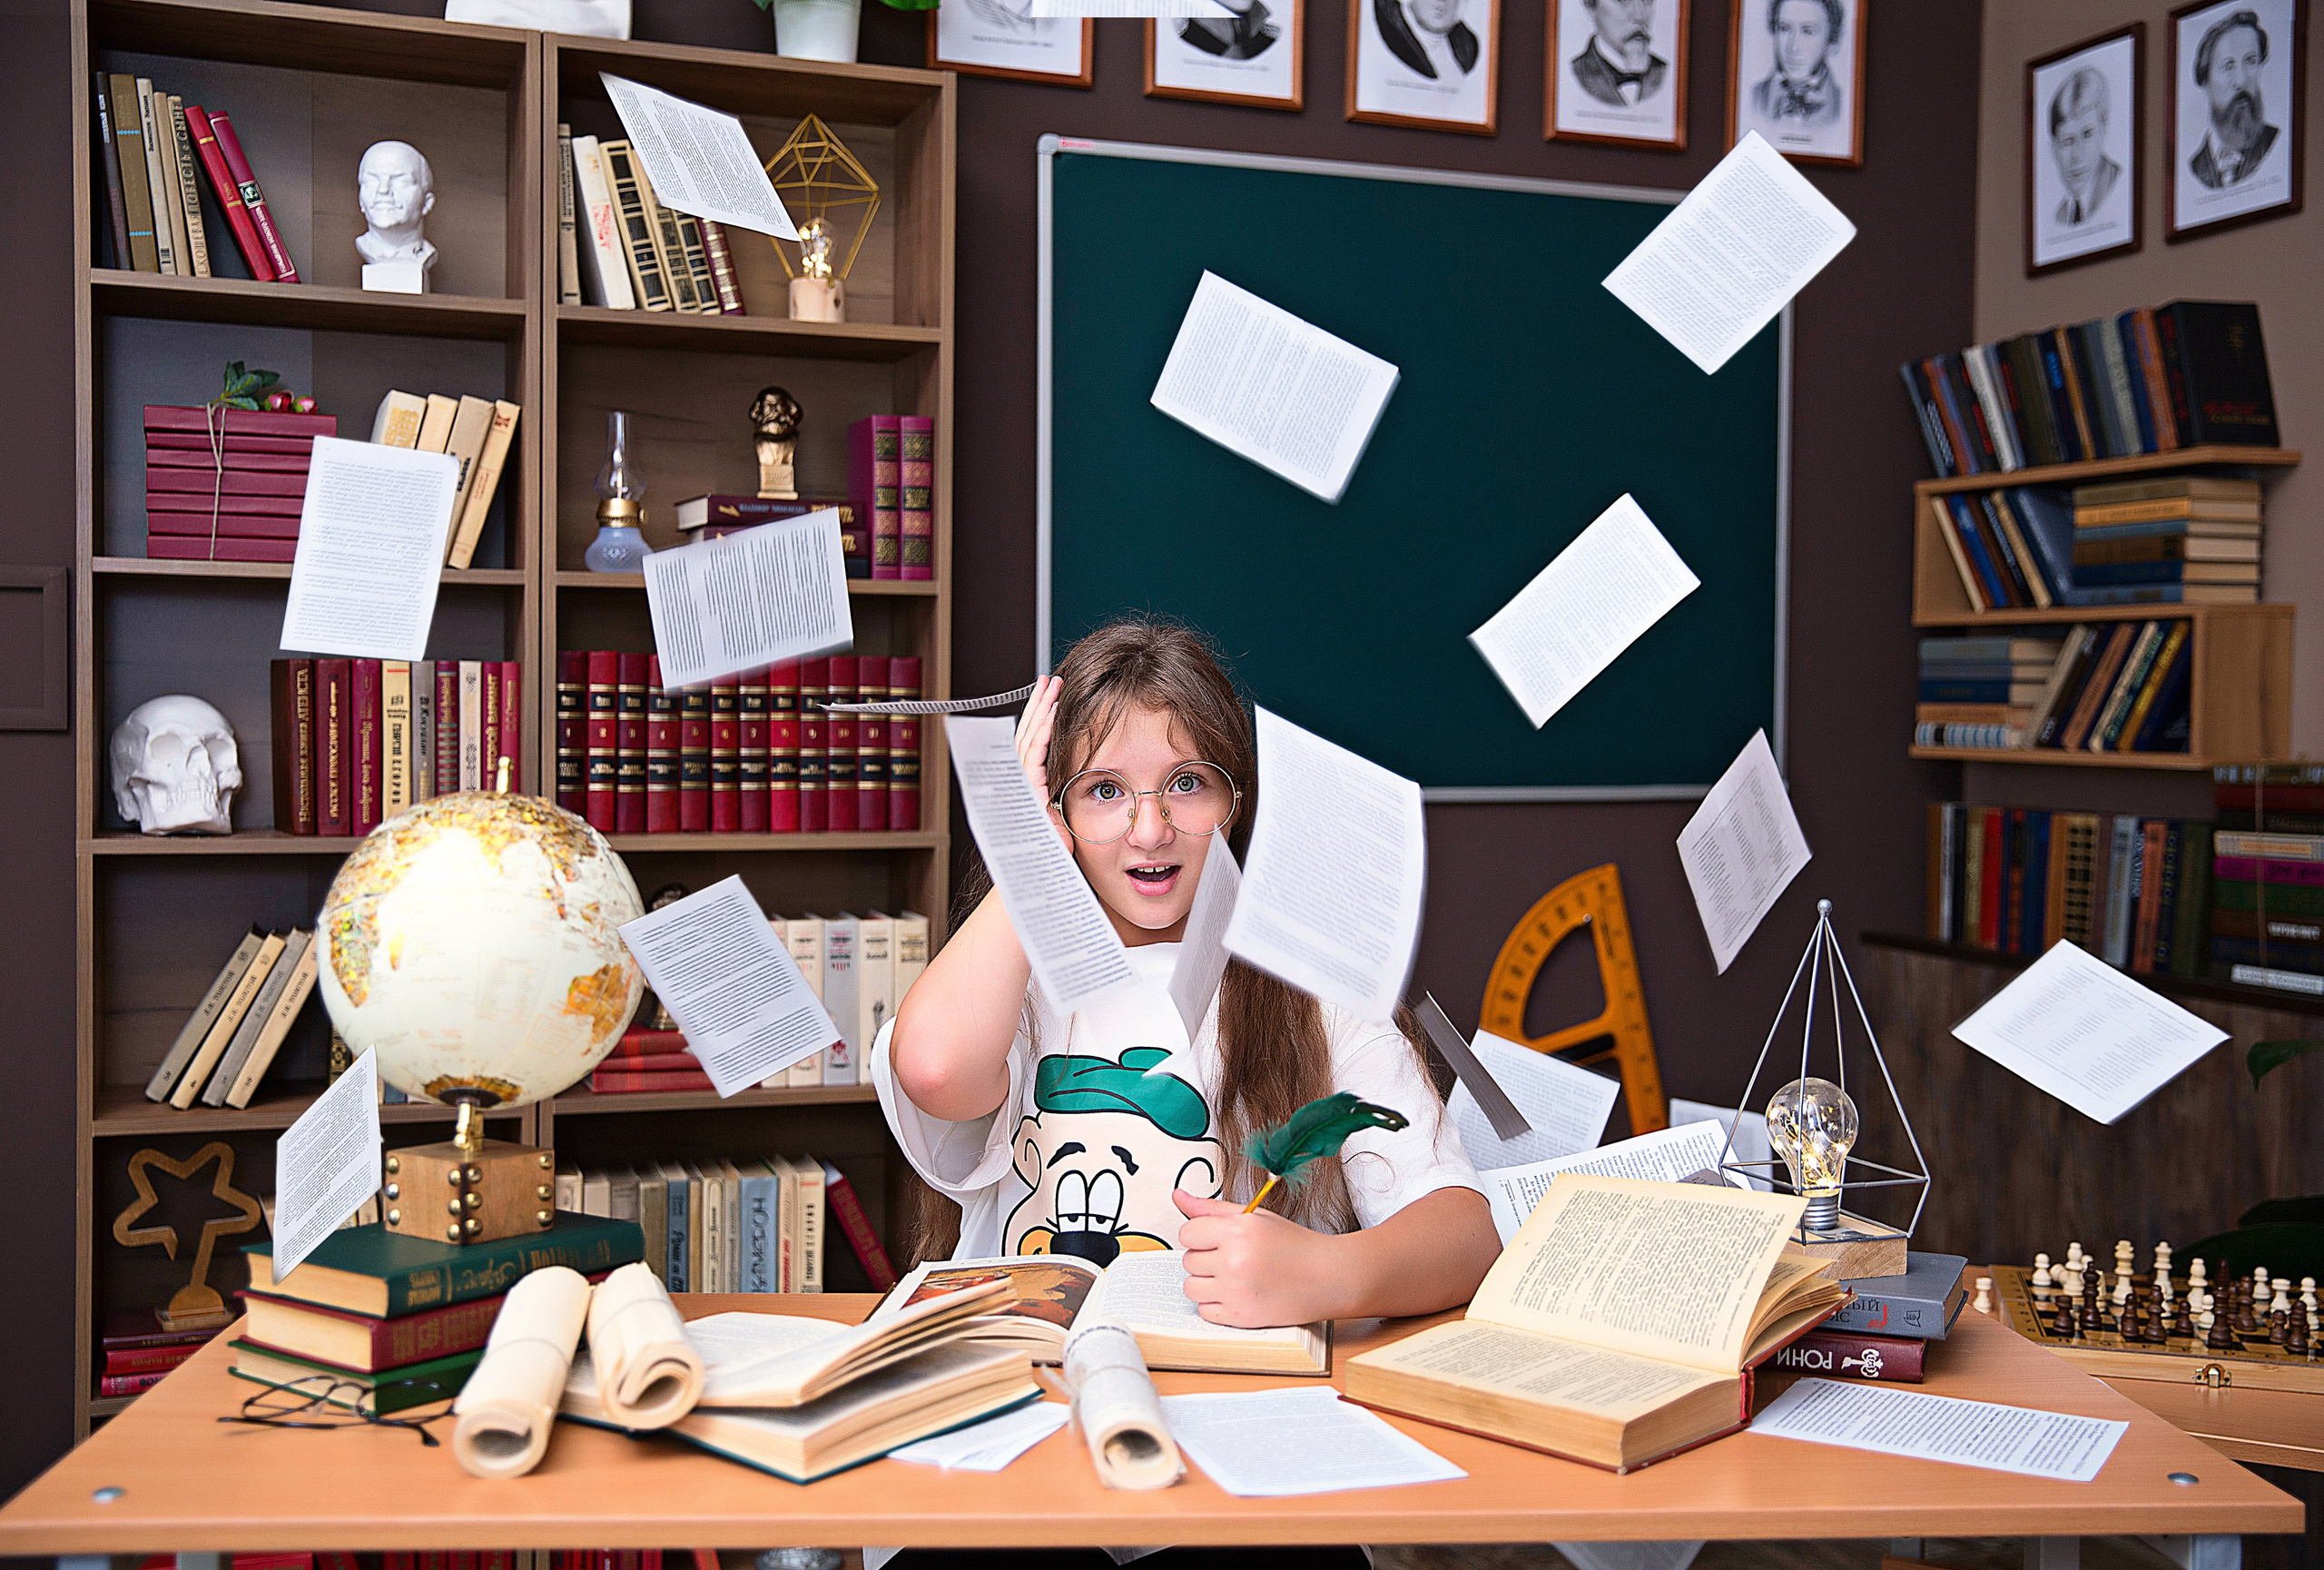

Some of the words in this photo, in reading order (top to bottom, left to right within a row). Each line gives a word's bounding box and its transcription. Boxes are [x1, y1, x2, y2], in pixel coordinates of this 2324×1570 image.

[172, 104, 188, 142] СЫНЕ
[181, 153, 200, 214] ПОВЕСТЬ
[296, 667, 309, 721] АТЕИСТА
[487, 673, 498, 724] ВАРИАНТ
[299, 723, 309, 755] книга
[599, 727, 606, 738] 2
[629, 727, 636, 738] 3
[660, 730, 665, 740] 4
[692, 726, 699, 736] 5
[722, 728, 729, 739] 6
[751, 727, 757, 739] 7
[809, 728, 817, 739] 9
[901, 729, 912, 739] 12
[486, 726, 498, 771] ВТОРОЙ
[391, 759, 401, 805] ЕГОРОВ
[1777, 1348, 1833, 1370] РОНИ
